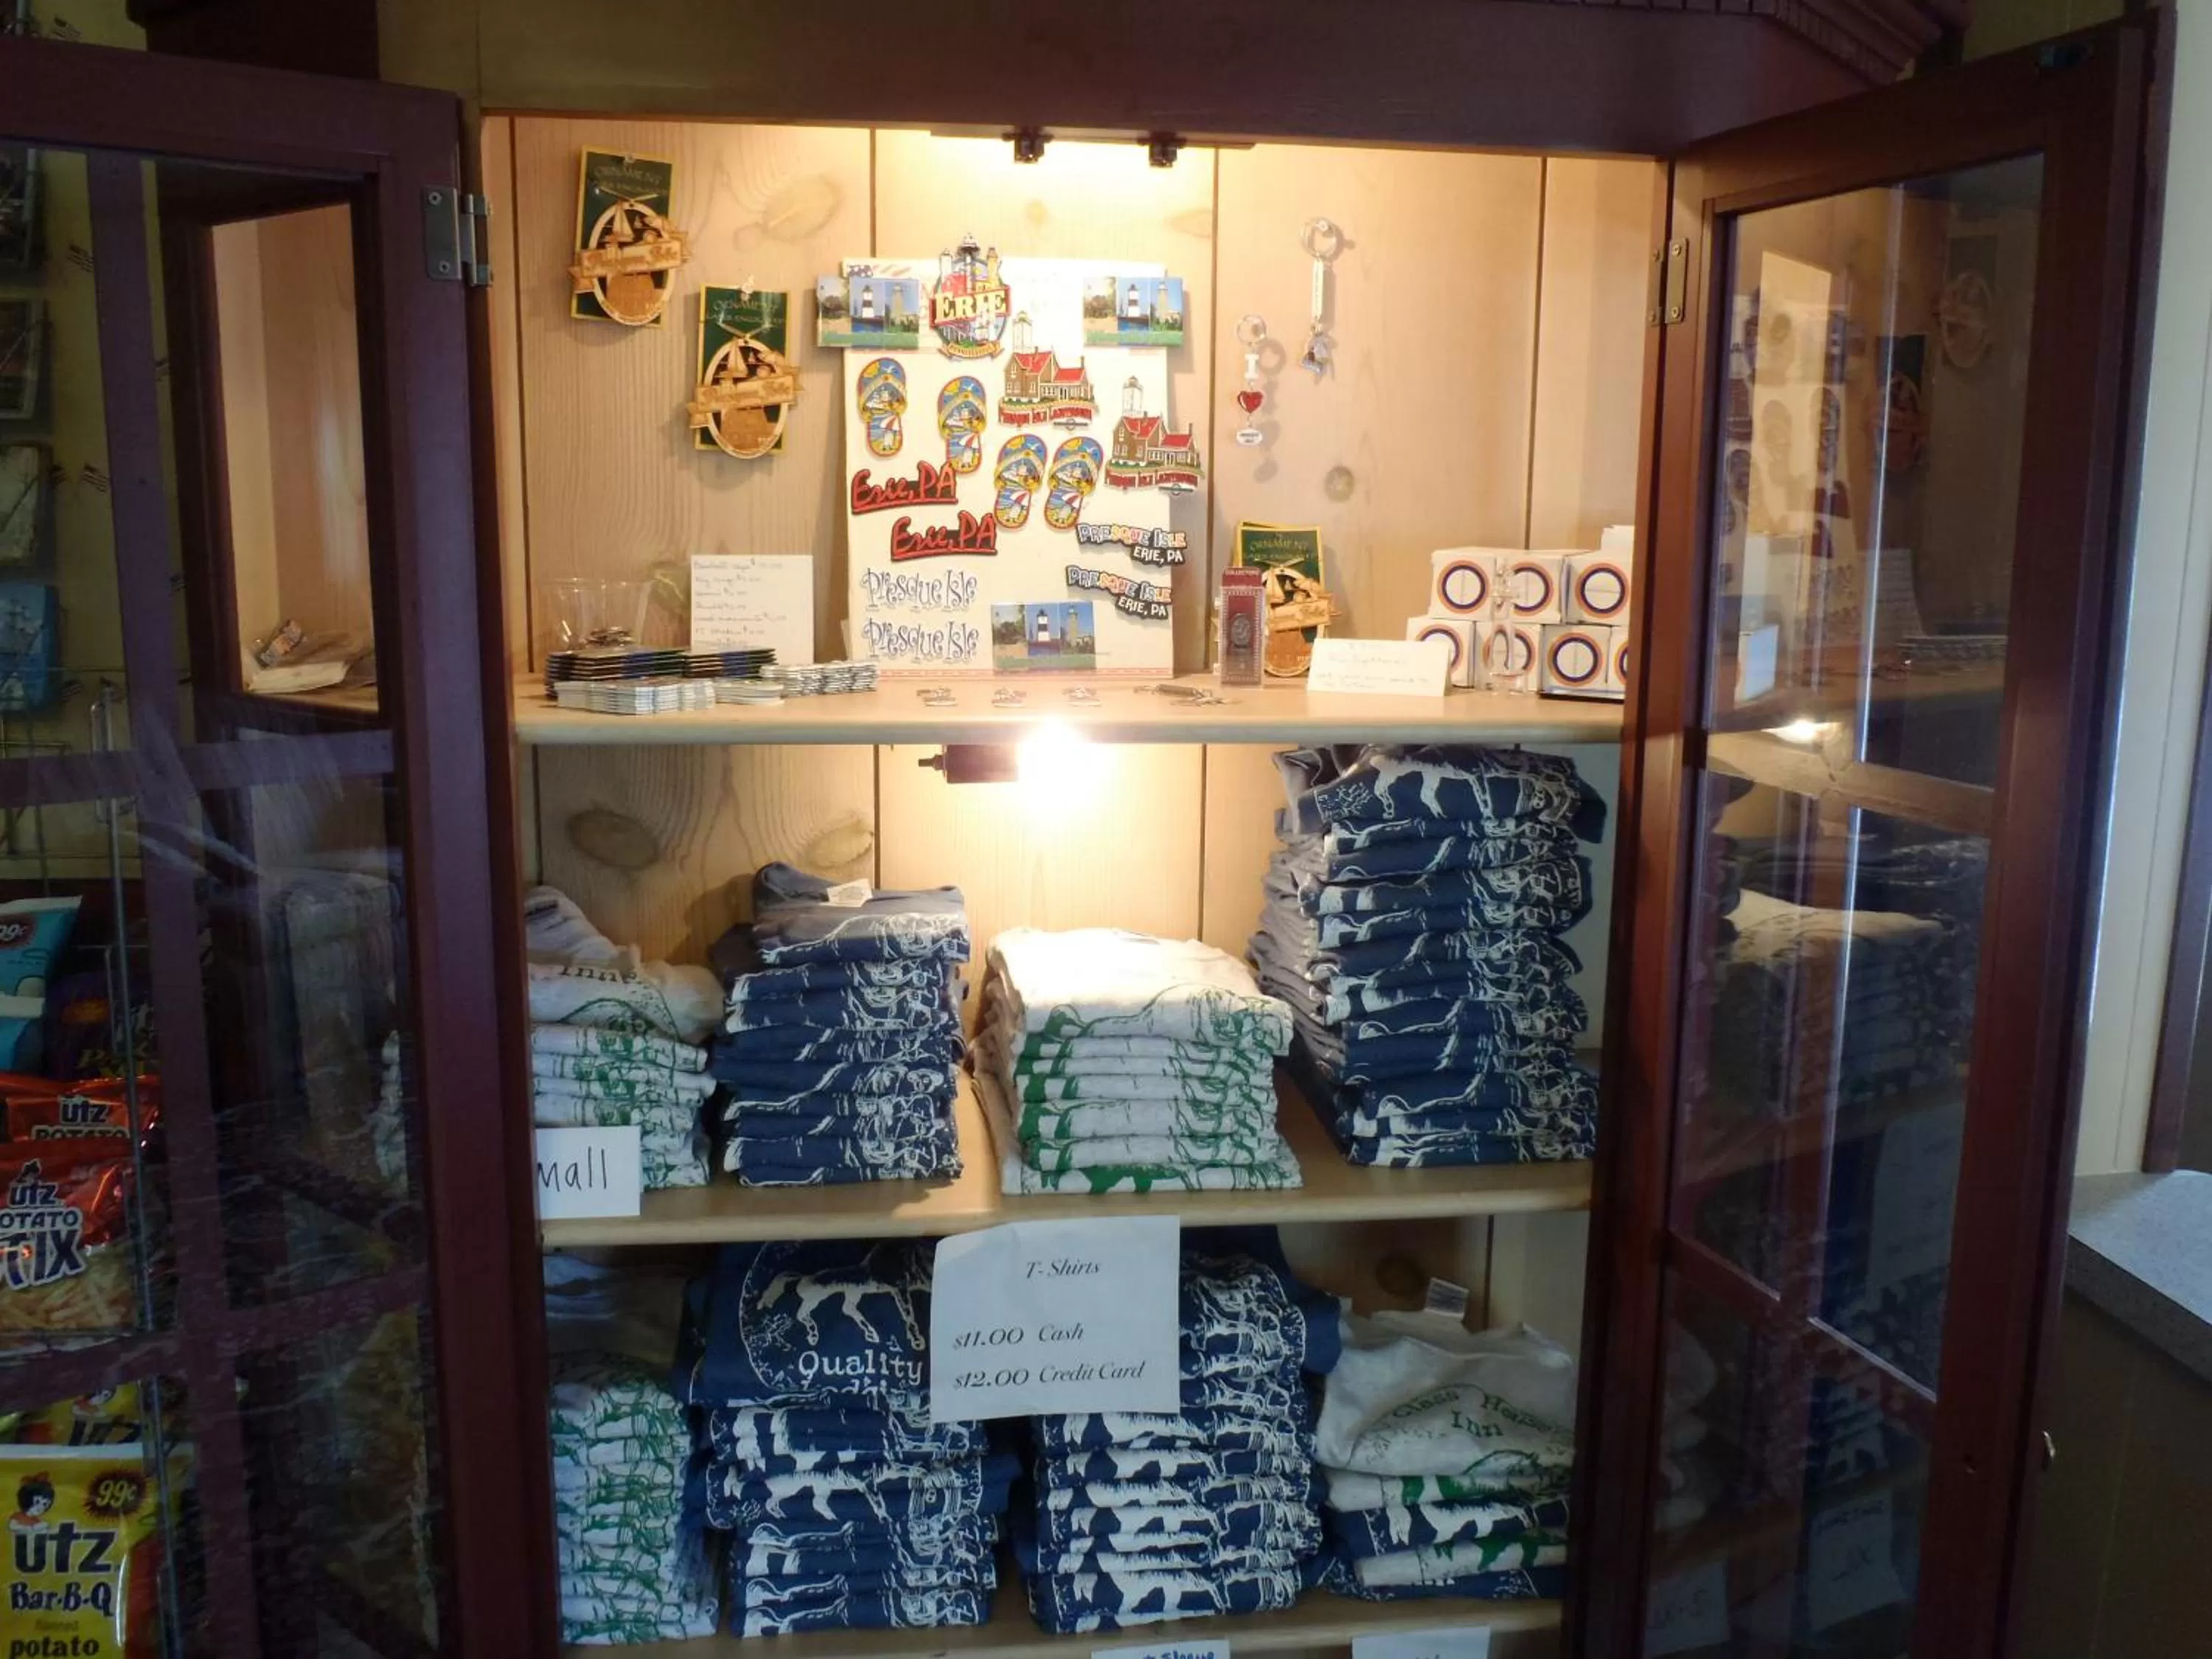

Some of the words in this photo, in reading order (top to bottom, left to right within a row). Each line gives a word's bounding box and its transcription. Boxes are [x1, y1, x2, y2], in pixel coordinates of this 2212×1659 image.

[935, 291, 1006, 321] ERIE
[917, 461, 956, 502] PA
[958, 510, 997, 550] PA
[1133, 546, 1164, 563] ERIE,
[1166, 550, 1183, 563] PA
[861, 568, 942, 609] Presque
[943, 569, 977, 609] Isle
[1118, 596, 1149, 616] ERIE,
[1150, 604, 1167, 617] PA
[863, 617, 944, 660] Presque
[945, 621, 979, 661] Isle
[0, 1209, 79, 1228] OTATO
[953, 1326, 1024, 1350] $11.00
[1038, 1322, 1084, 1342] Cash
[799, 1349, 922, 1386] Quality
[953, 1368, 1029, 1390] $12.00
[1039, 1362, 1093, 1384] Credit
[1099, 1360, 1147, 1380] Card
[1450, 1408, 1503, 1438] Inn
[10, 1633, 100, 1659] potato
